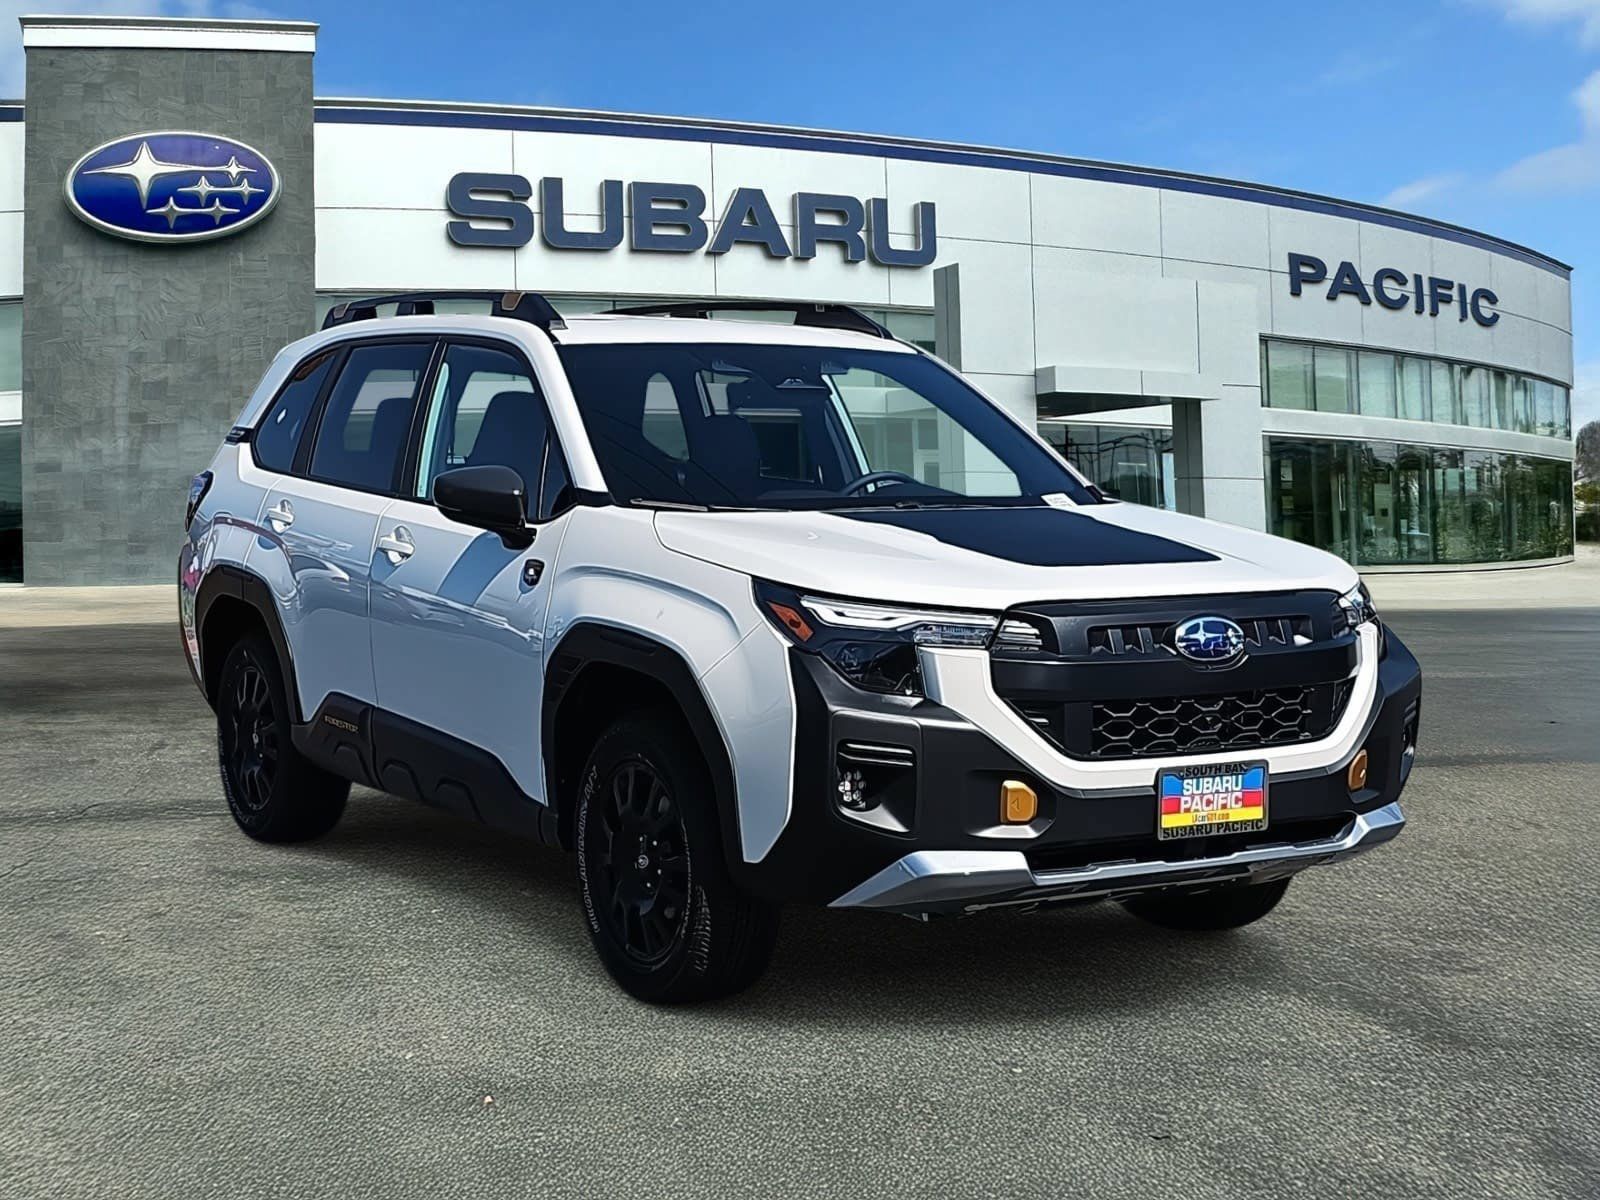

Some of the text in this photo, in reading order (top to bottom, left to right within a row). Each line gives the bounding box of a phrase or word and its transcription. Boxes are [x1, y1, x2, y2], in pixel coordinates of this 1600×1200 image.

[446, 171, 937, 268] SUBARU
[1288, 252, 1500, 328] PACIFIC
[1184, 763, 1248, 777] SOUTH BAY
[1182, 774, 1243, 796] SUBARU
[1180, 792, 1243, 813] PACIFIC
[1162, 820, 1264, 840] SUBARU PACIFIC
